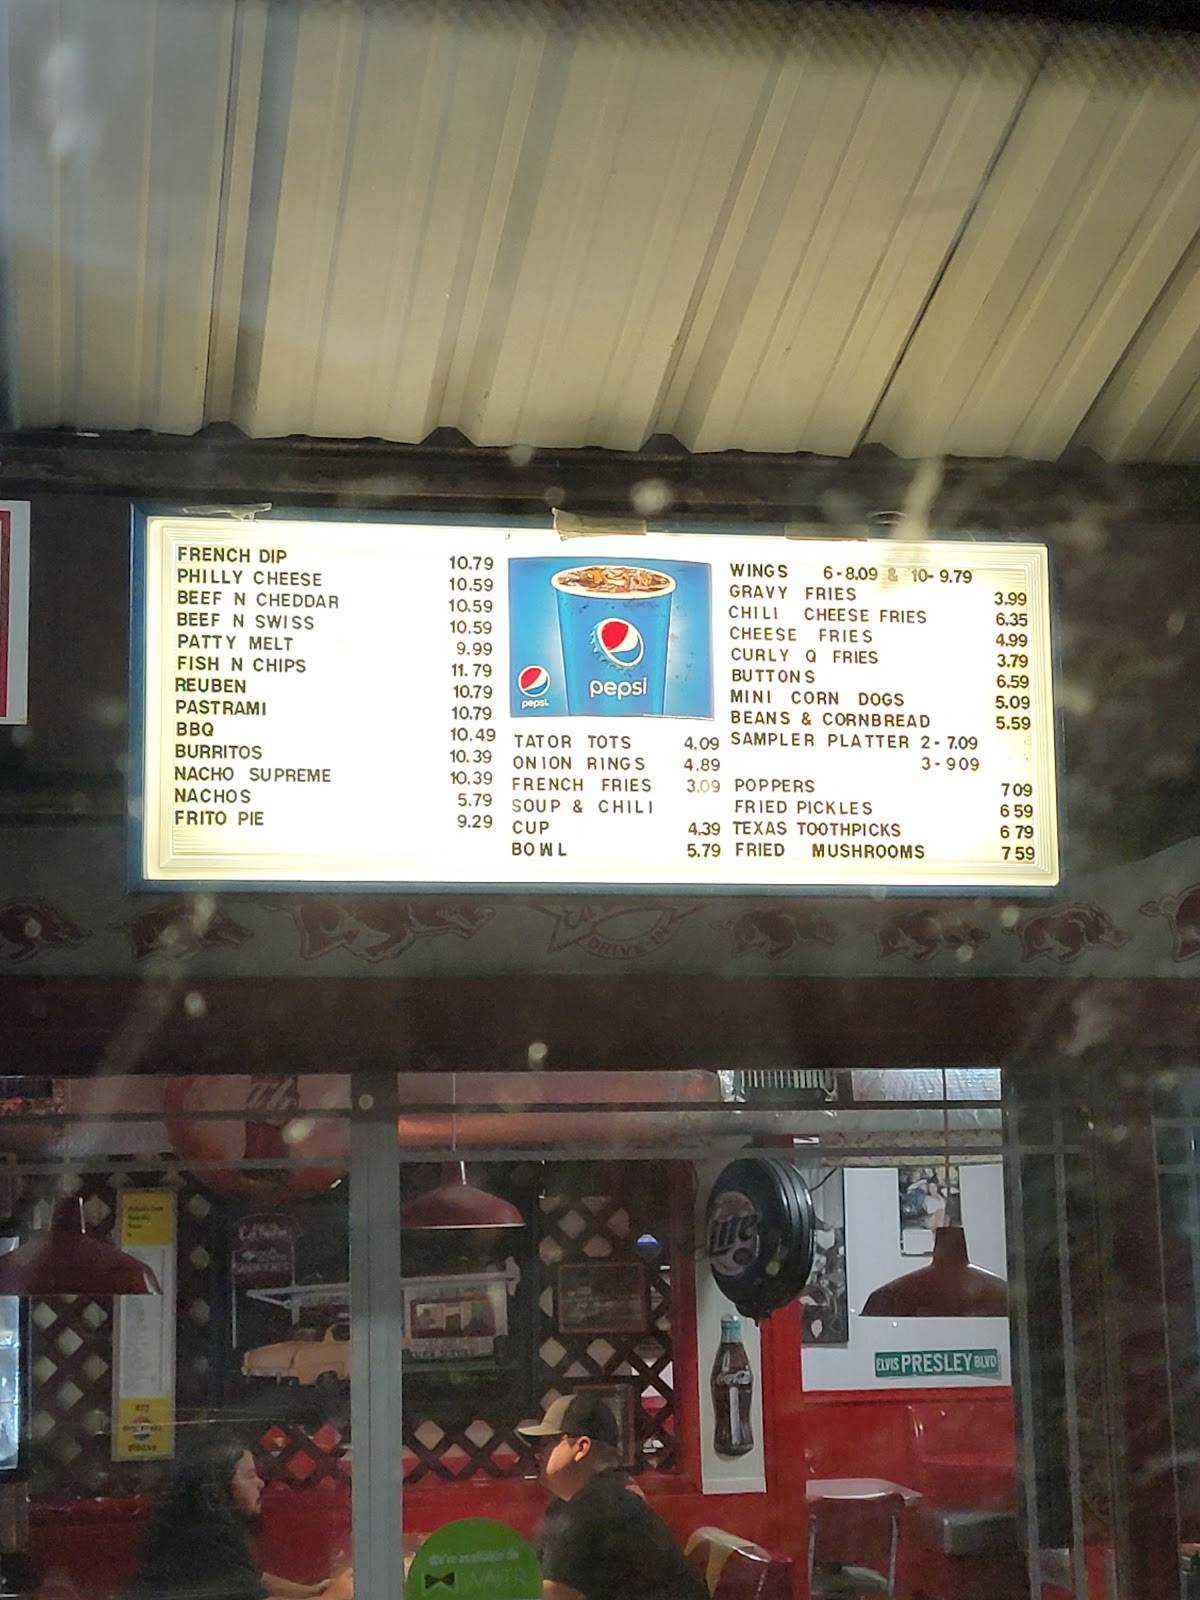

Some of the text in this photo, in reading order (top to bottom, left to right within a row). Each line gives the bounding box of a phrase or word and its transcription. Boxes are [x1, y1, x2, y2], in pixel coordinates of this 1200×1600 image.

[178, 545, 493, 570] FRENCH DIP 10.79
[178, 568, 493, 592] PHILLY CHEESE 10.59
[730, 563, 788, 578] WINGS
[888, 568, 898, 581] &
[940, 569, 973, 584] 9.79
[178, 590, 492, 613] BEEF N CHEDDAR 10.59
[729, 584, 1027, 606] GRAVY FRIES 3.99
[177, 612, 492, 635] BEEF N SWISS 10.59
[728, 605, 1028, 627] CHILI CHEESE FRIES 6.35
[178, 634, 492, 656] PATTY MELT 9.99
[730, 626, 1028, 647] CHEESE FRIES 4.99
[178, 656, 492, 678] FISH N CHIPS 11.79
[731, 648, 1028, 668] CURLY Q FRIES 3.79
[175, 677, 492, 699] REUBEN 10.79
[590, 677, 647, 700] pepsi
[732, 669, 1029, 689] BUTTONS 6.59
[521, 699, 549, 709] pepsi
[731, 689, 1030, 710] MINI CORN DOGS 5.09
[176, 700, 492, 720] PASTRAMI 10.79
[731, 710, 1031, 730] BEANS & CORNBREAD 5.59
[176, 722, 496, 742] BBQ 10.49
[514, 734, 719, 750] TATOR TOTS 4.09
[731, 732, 814, 746] SAMPLER
[828, 734, 909, 748] PLATTER
[947, 736, 978, 750] 7.09
[175, 744, 492, 764] BURRITOS 10.39
[513, 755, 720, 771] ONION RINGS 4.89
[174, 766, 492, 785] NACHO SUPREME 10.39
[512, 777, 720, 792] FRENCH FRIES 3.09
[735, 778, 815, 793] POPPERS
[175, 788, 492, 807] NACHOS 5.79
[512, 799, 652, 814] SOUP & CHILI
[735, 800, 787, 814] FRIED
[797, 801, 872, 815] PICKLES
[175, 810, 492, 829] FRITO PIE 9.29
[512, 820, 720, 836] CUP 4.39
[732, 821, 787, 835] TEXAS
[796, 822, 901, 837] TOOTHPICKS
[512, 842, 721, 858] BOWL 5.79
[736, 842, 785, 857] FRIED
[812, 843, 924, 859] MUSHROOMS
[877, 1353, 997, 1373] ELVIS PRESLEY BLVD
